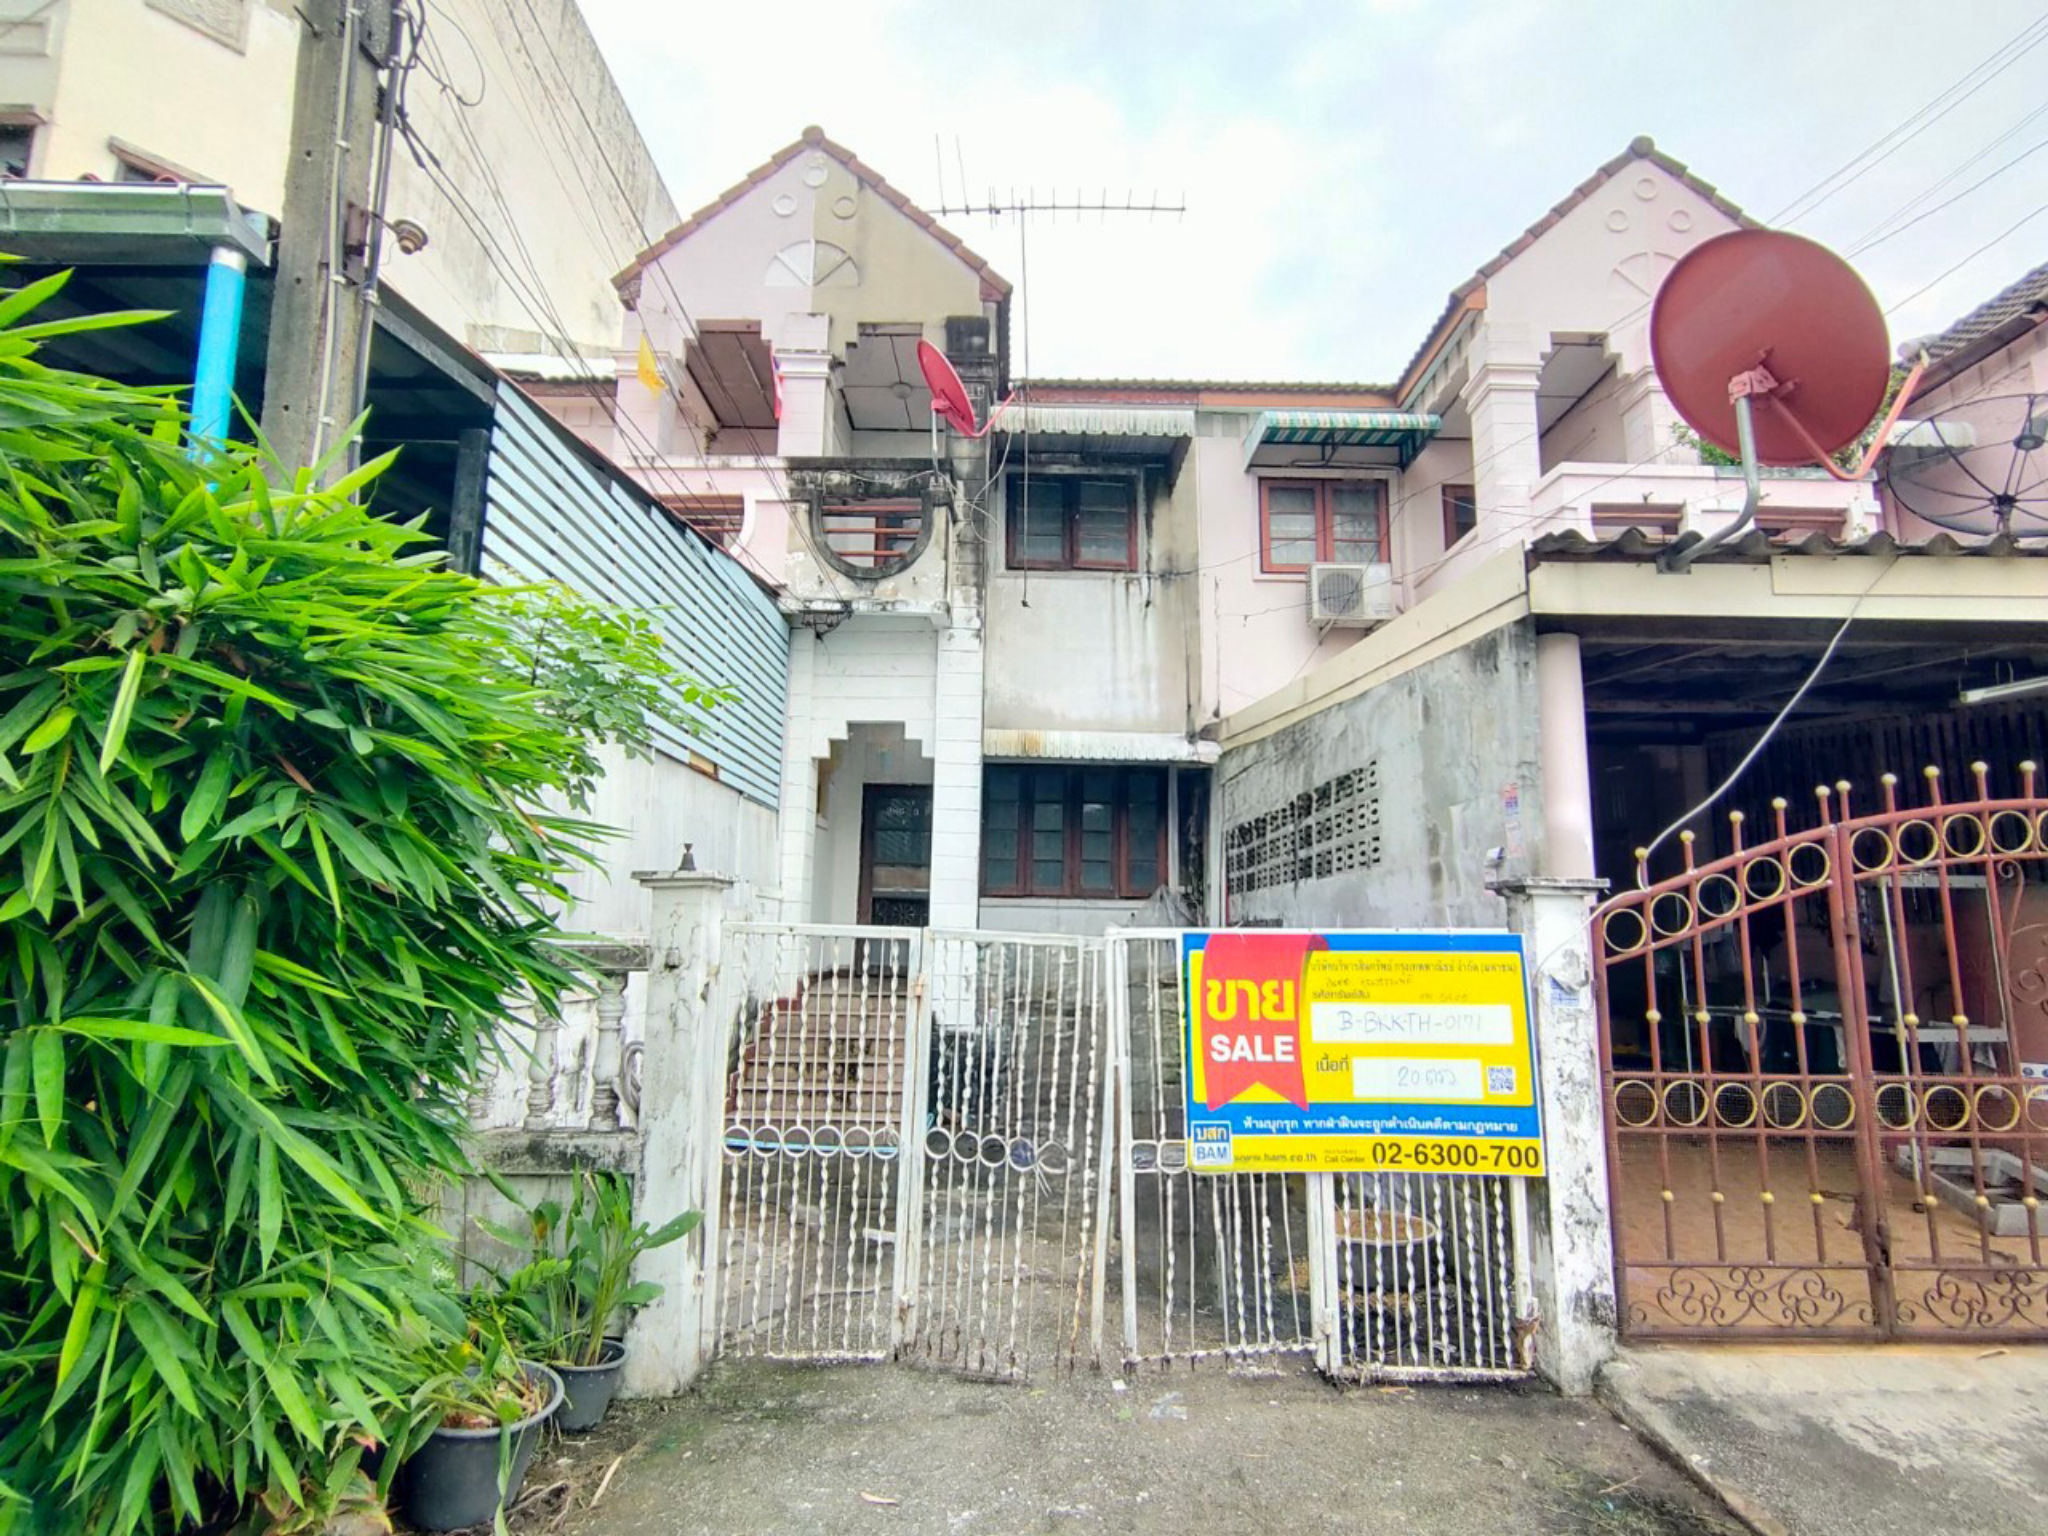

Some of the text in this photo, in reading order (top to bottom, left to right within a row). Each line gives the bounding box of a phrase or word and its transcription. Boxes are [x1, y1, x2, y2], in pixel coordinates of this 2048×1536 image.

[1206, 979, 1295, 1021] ขาย
[1210, 1034, 1295, 1063] SALE
[1315, 1052, 1350, 1073] เนื้อที่
[1196, 1146, 1227, 1161] BAM
[1372, 1142, 1540, 1168] 02-6300-700
